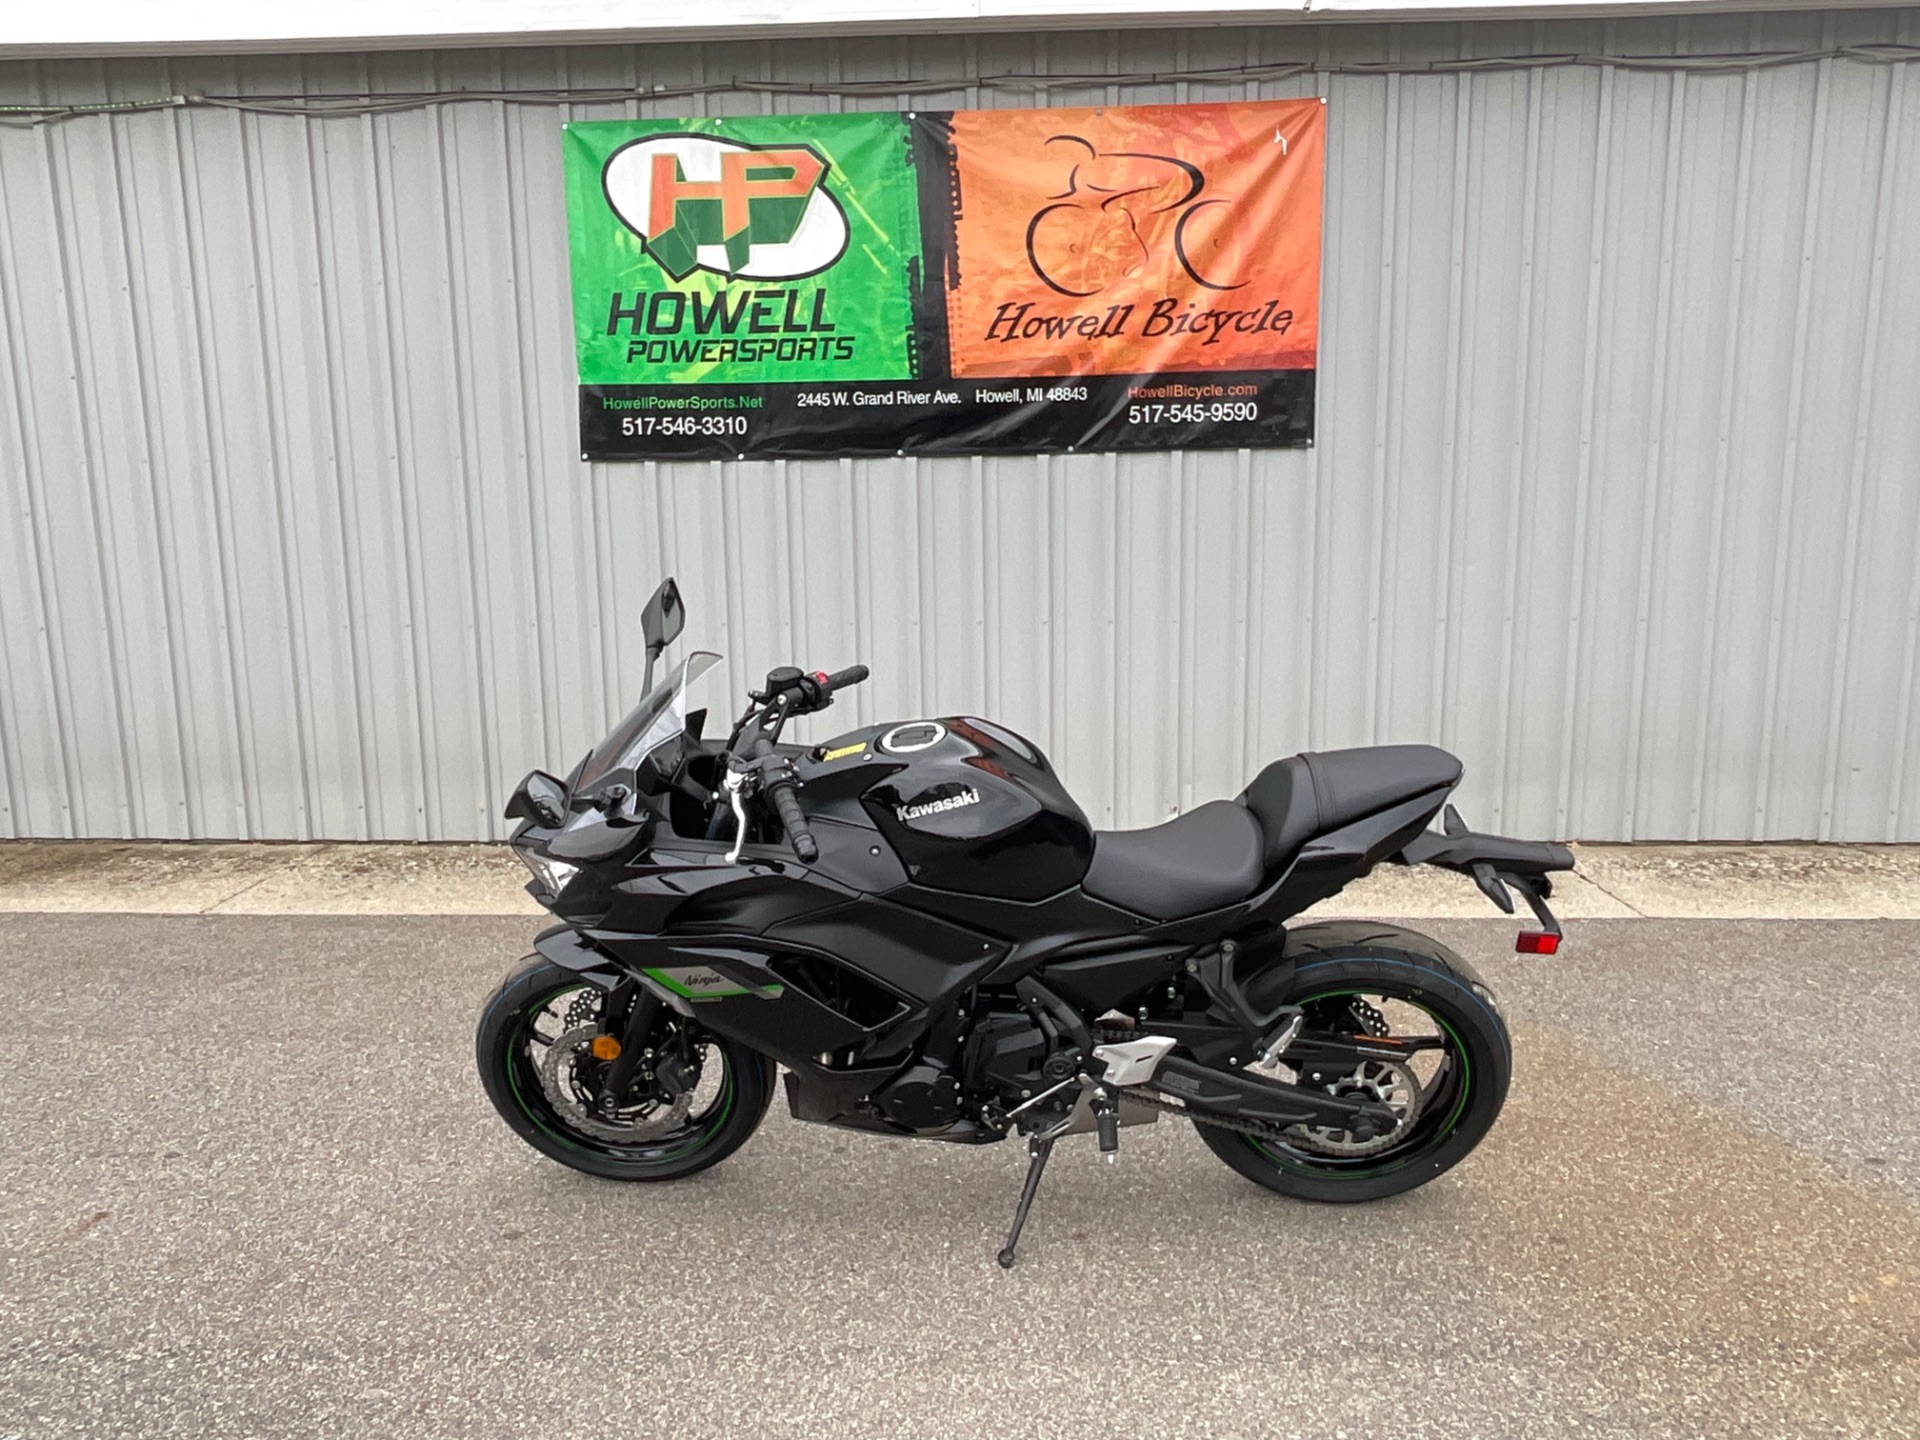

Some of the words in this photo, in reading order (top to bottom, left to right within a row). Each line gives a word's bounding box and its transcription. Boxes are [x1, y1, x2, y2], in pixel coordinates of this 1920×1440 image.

[606, 288, 836, 336] HOWELL
[984, 302, 1135, 344] Howell
[1141, 297, 1294, 346] Bicycle
[626, 336, 855, 364] POWERSPORTS
[797, 393, 831, 407] 2445
[832, 392, 850, 406] W.
[852, 391, 894, 406] Grand
[896, 390, 930, 404] River
[933, 390, 961, 404] Ave.
[975, 389, 1023, 404] Howell,
[1026, 388, 1043, 402] MI
[1045, 387, 1088, 401] 48843
[1127, 384, 1258, 400] HowellBicycle.com
[602, 395, 763, 411] HowellPowerSports.Net
[1128, 402, 1258, 424] 517-545-9590
[621, 416, 748, 436] 517-546-3310
[896, 788, 981, 822] Kawasaki
[684, 972, 725, 987] Ninja
